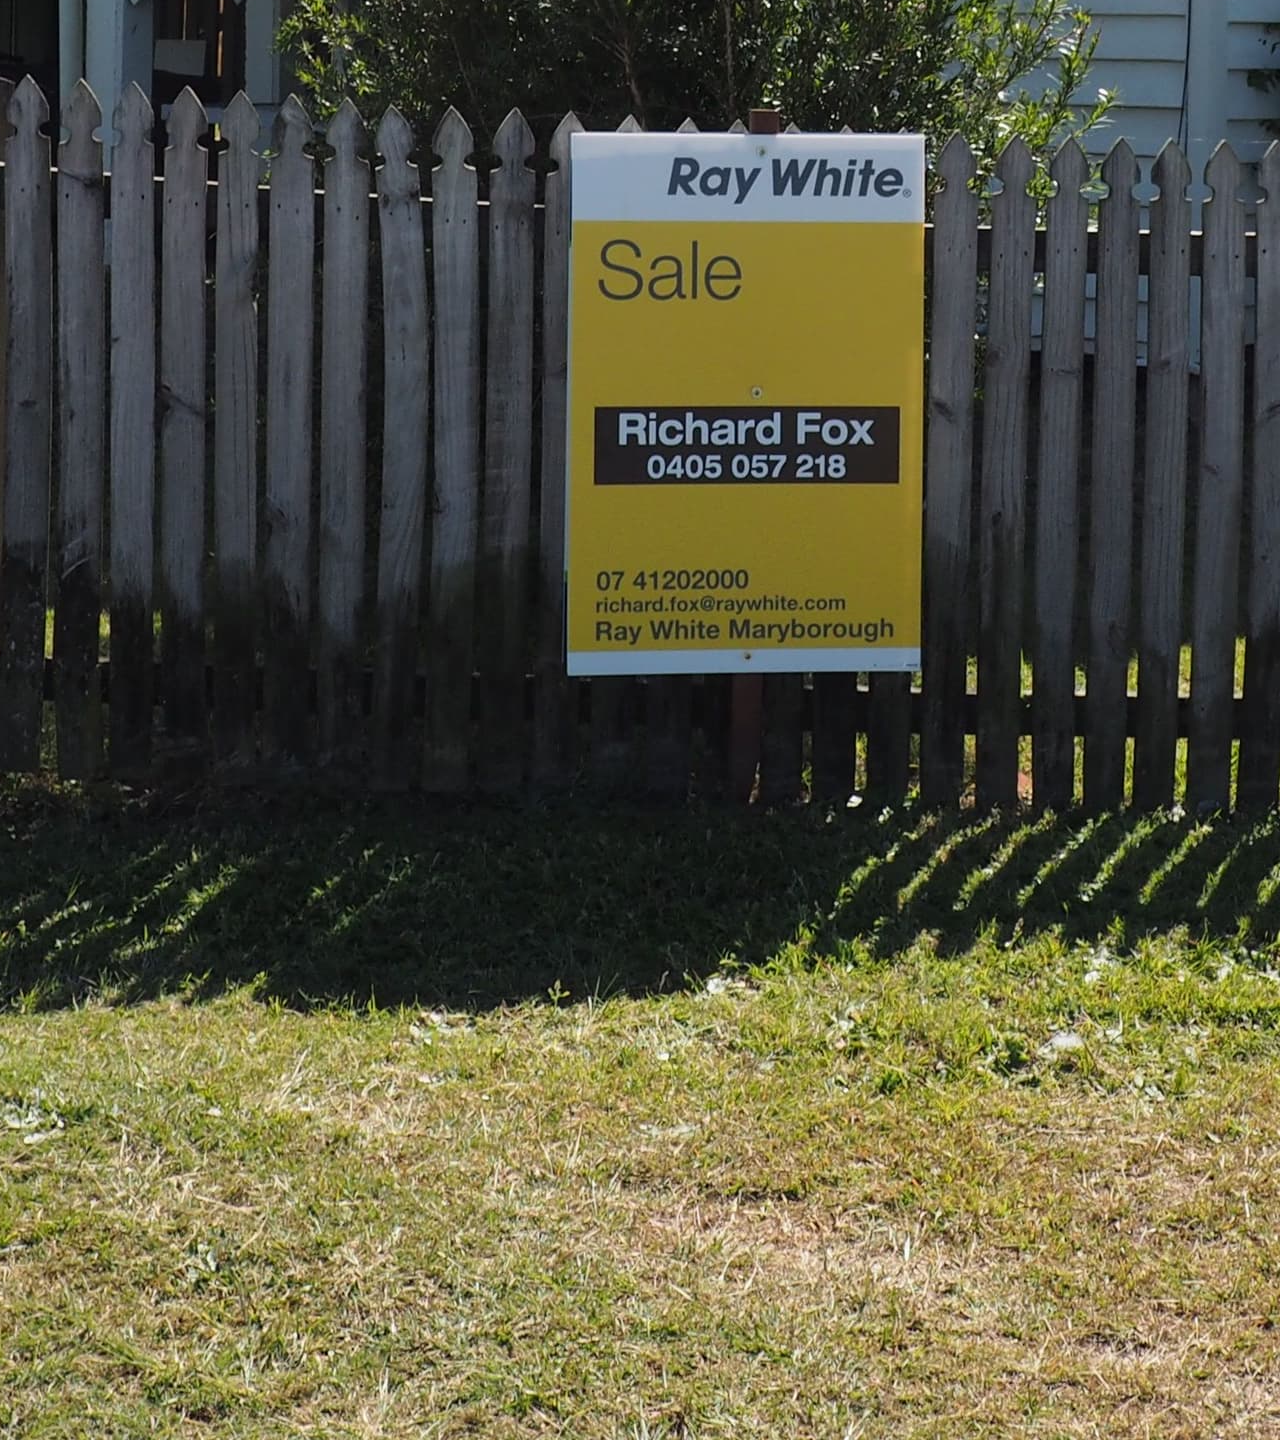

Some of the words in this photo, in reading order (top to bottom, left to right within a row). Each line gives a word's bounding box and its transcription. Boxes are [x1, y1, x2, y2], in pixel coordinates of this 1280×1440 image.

[667, 157, 762, 205] Ray
[598, 239, 743, 302] Sale
[618, 411, 782, 447] Richard
[796, 411, 875, 446] Fox
[647, 455, 723, 480] 0405
[731, 455, 788, 479] 057
[795, 454, 847, 479] 218
[596, 570, 625, 591] 07
[632, 569, 750, 591] 41202000
[595, 595, 847, 615] richard.fox@raywhite.com
[595, 620, 642, 645] Ray
[649, 619, 721, 641] White
[728, 617, 895, 643] Maryborough
